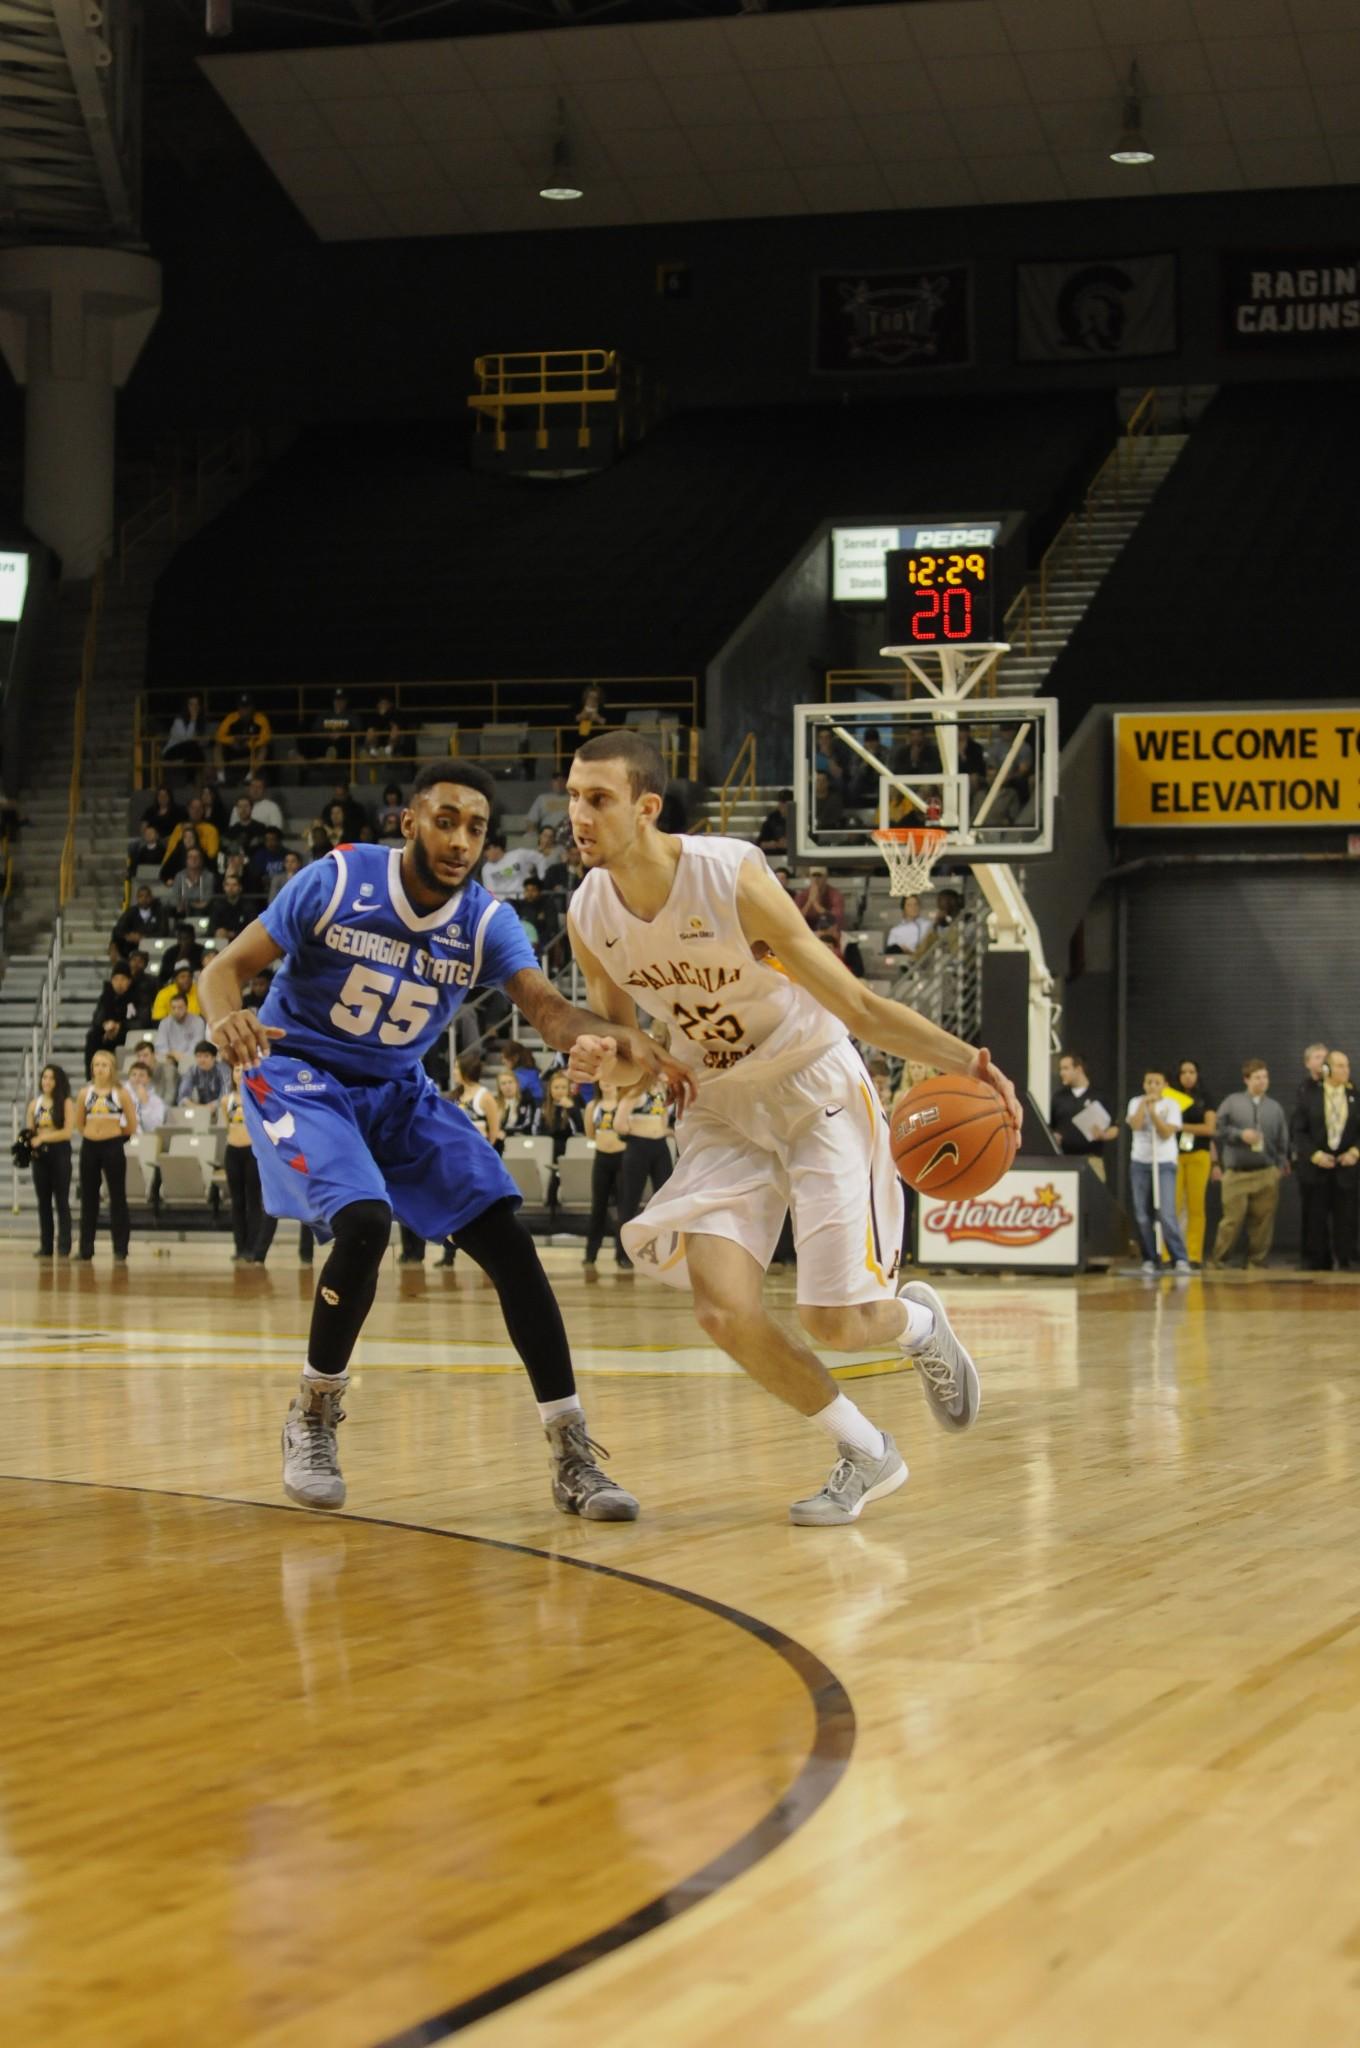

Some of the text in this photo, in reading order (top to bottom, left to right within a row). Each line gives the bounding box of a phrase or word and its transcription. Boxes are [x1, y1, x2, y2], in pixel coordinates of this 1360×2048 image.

[1236, 300, 1360, 332] CAJUNS
[915, 529, 992, 550] PEPSI
[908, 554, 985, 586] 12:29
[911, 588, 972, 640] 20
[1134, 727, 1360, 761] WELCOME T
[1151, 780, 1339, 813] ELEVATION
[325, 924, 472, 986] GEORGIA STATE
[330, 963, 439, 1046] 55
